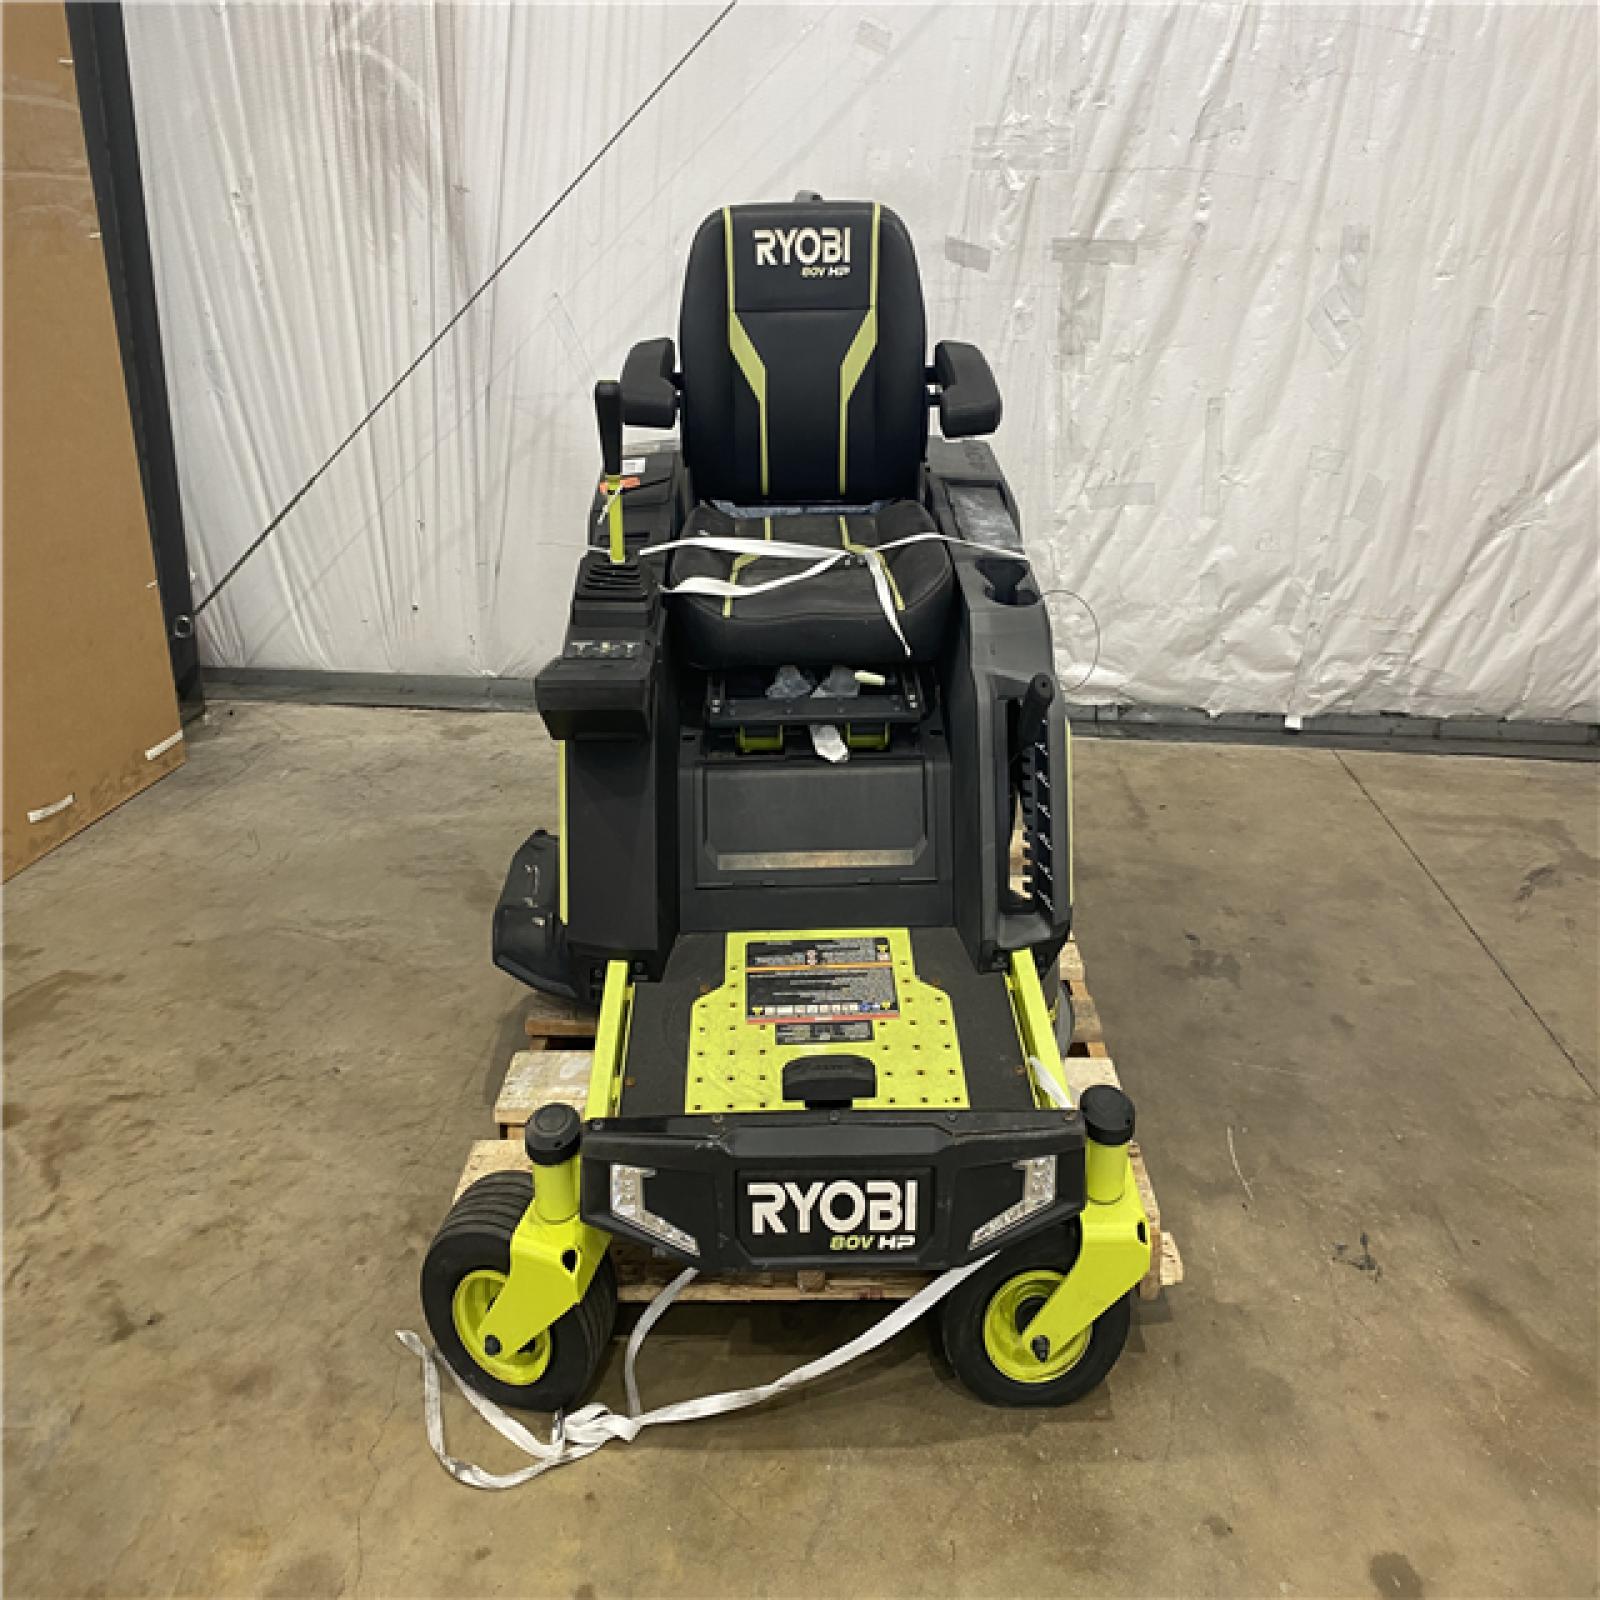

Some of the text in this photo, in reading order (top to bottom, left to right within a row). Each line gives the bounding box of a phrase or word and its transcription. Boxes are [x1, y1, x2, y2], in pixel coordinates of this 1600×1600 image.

[753, 226, 851, 266] RYOBI
[827, 265, 851, 277] HP
[747, 1179, 918, 1235] RYOBI
[829, 1234, 917, 1251] 80V HP
